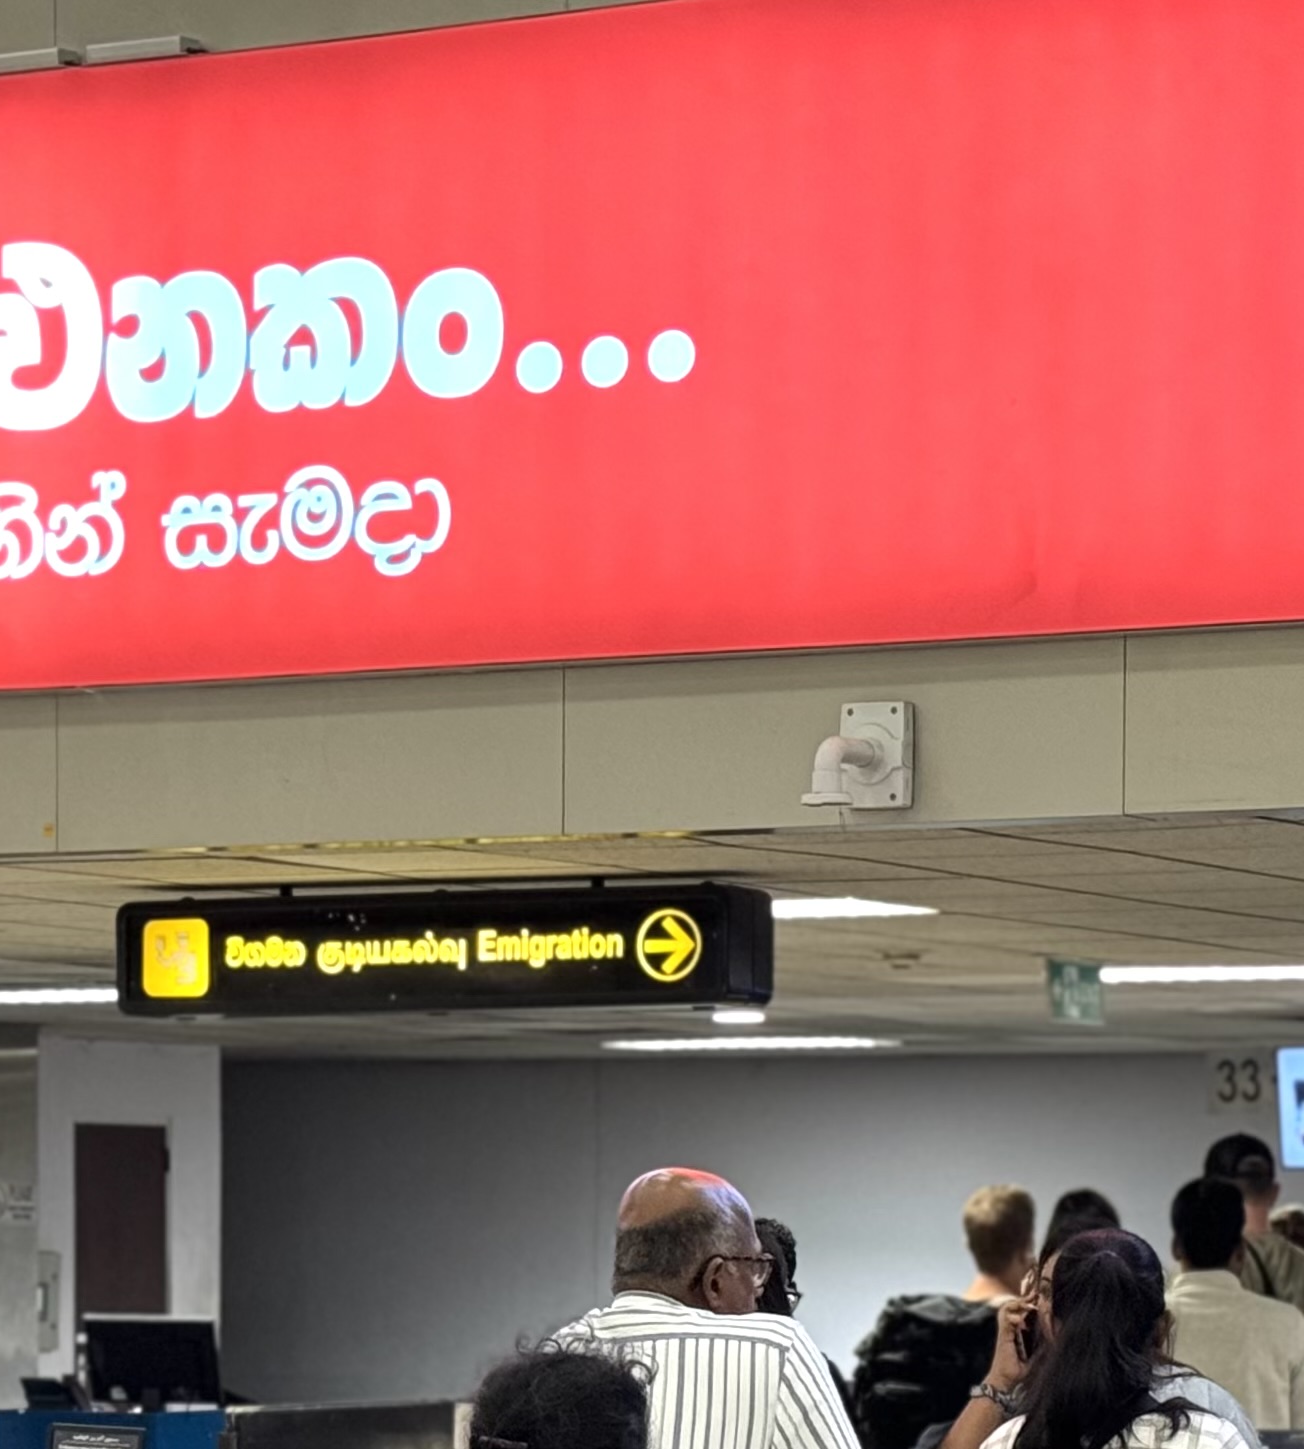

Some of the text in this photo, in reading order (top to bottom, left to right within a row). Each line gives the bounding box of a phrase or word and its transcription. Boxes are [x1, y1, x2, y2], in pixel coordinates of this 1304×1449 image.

[161, 464, 451, 578] සැමදා
[316, 930, 468, 975] குடியகல்வு
[477, 927, 624, 968] Emigration
[1216, 1058, 1262, 1103] 33
